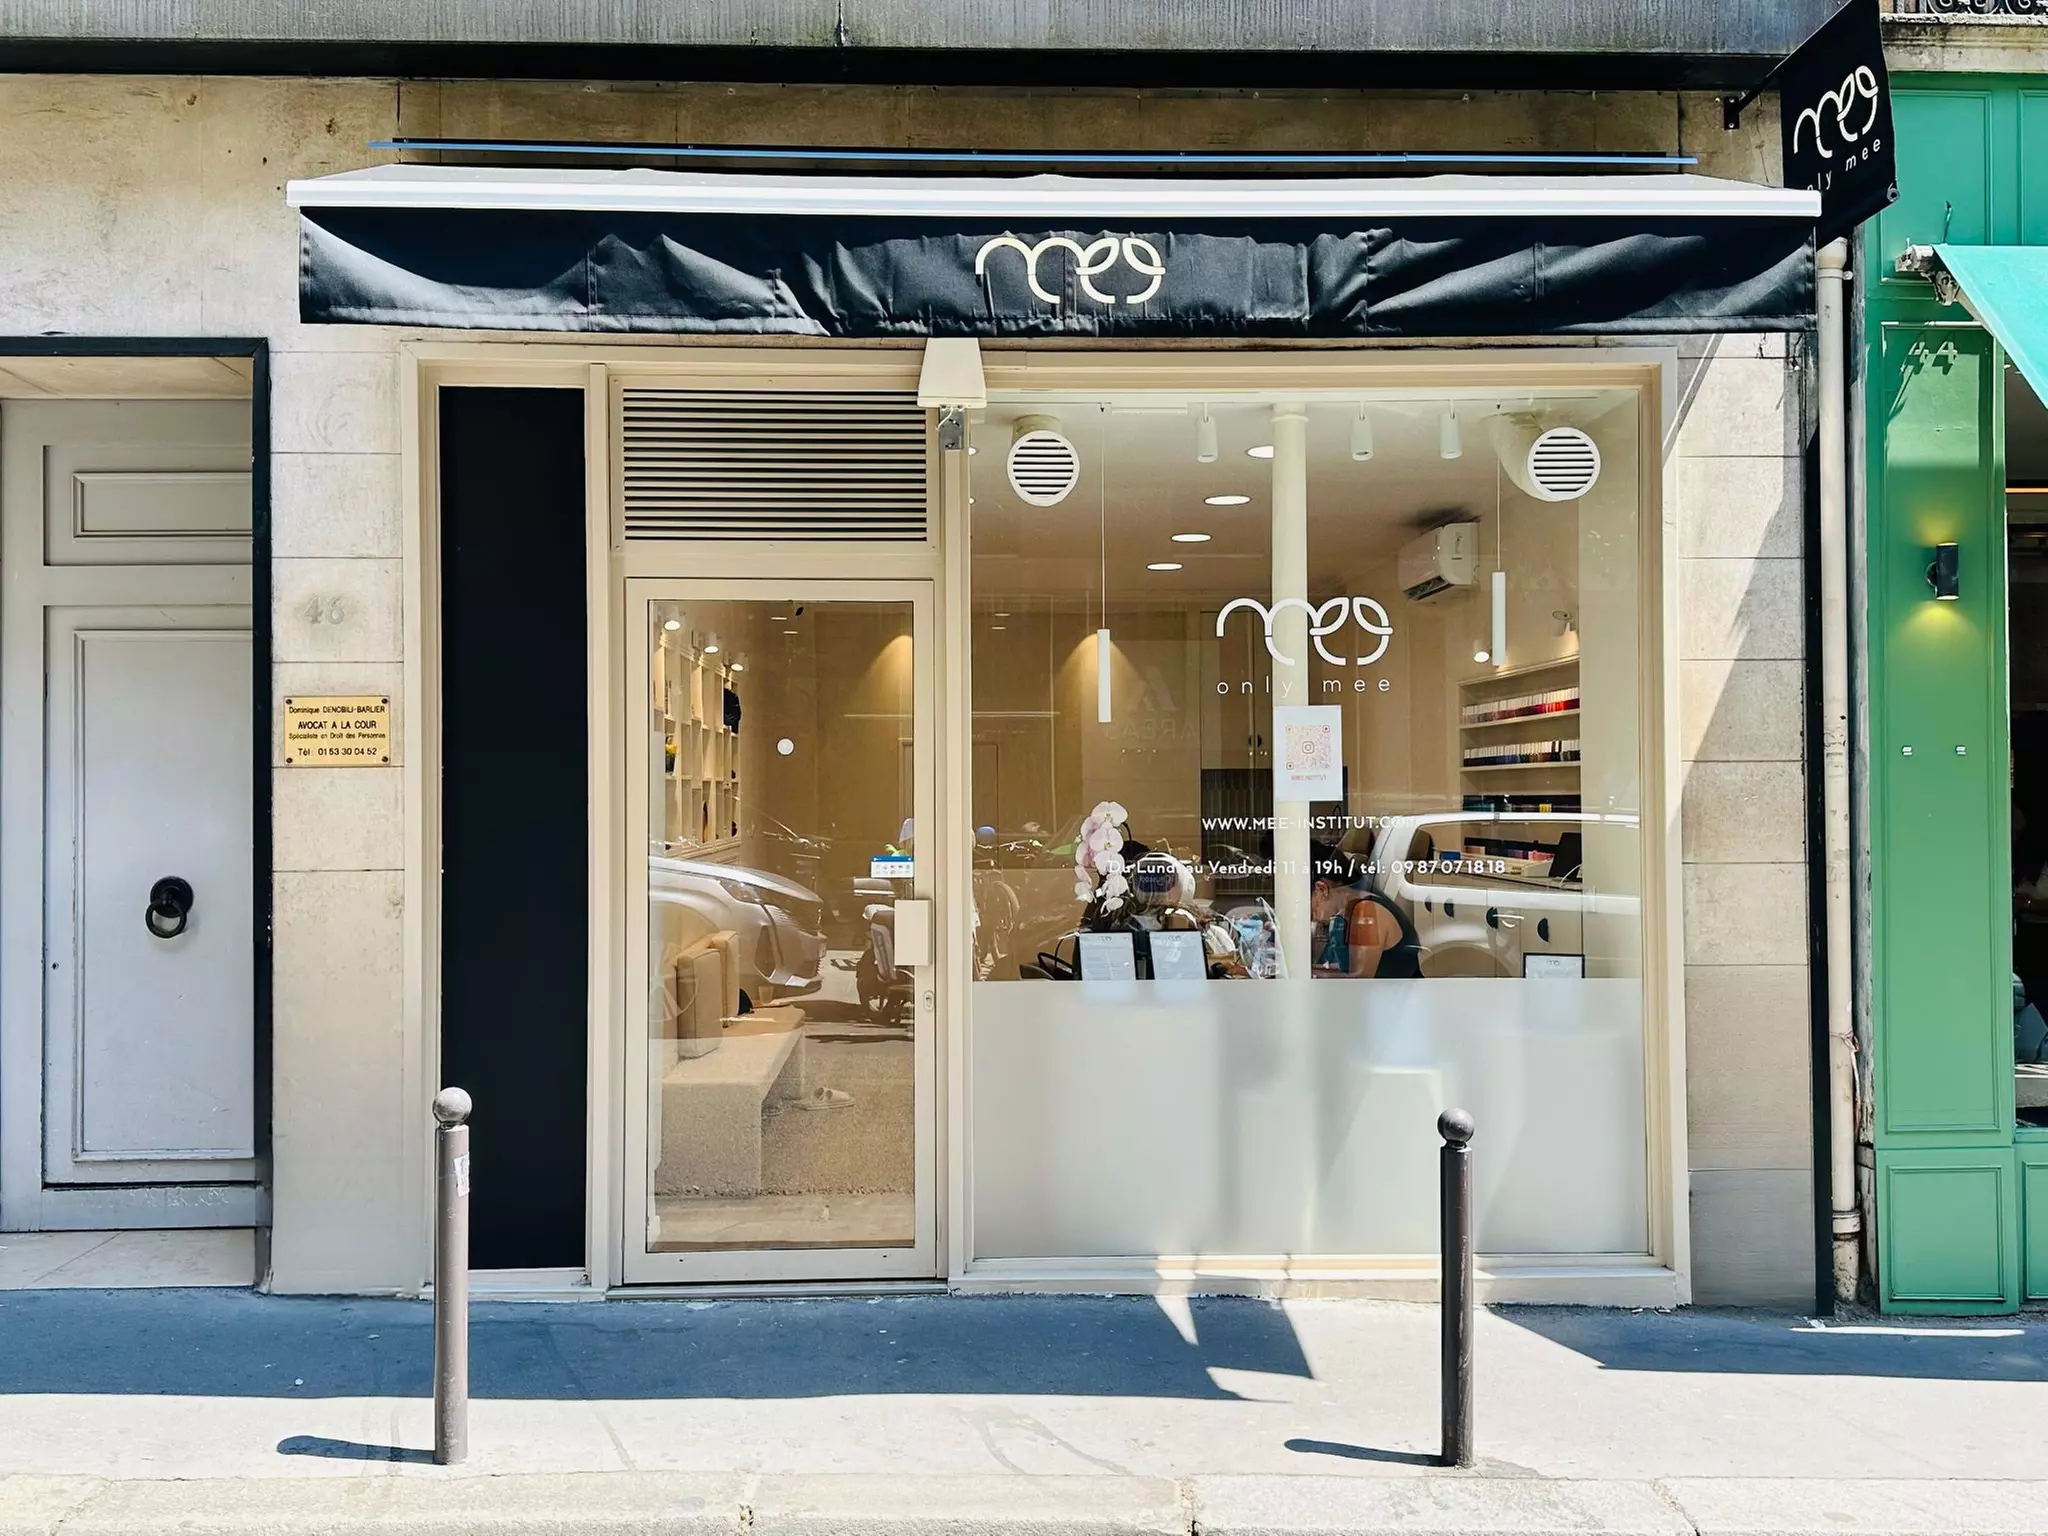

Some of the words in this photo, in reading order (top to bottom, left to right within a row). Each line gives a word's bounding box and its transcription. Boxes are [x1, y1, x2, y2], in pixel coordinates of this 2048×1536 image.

[1845, 138, 1881, 172] mee
[304, 594, 345, 625] 46
[1216, 675, 1293, 699] only
[1322, 678, 1391, 694] mee
[288, 706, 320, 715] Dominique
[298, 720, 328, 730] AVOCAT
[331, 720, 338, 730] A
[340, 720, 351, 730] LA
[354, 720, 377, 730] COUR
[288, 732, 318, 740] Spécialiste
[341, 748, 353, 756] 30
[354, 748, 365, 756] 04
[366, 747, 378, 756] 52
[1201, 815, 1415, 831] WWW.MEE-INSTITUT.CO
[1137, 859, 1179, 874] Lund
[1186, 864, 1204, 874] au
[1208, 859, 1276, 874] Vendredi
[1283, 860, 1296, 874] 11
[1315, 860, 1343, 874] 19h
[1347, 858, 1356, 878] /
[1360, 859, 1386, 874] tél:
